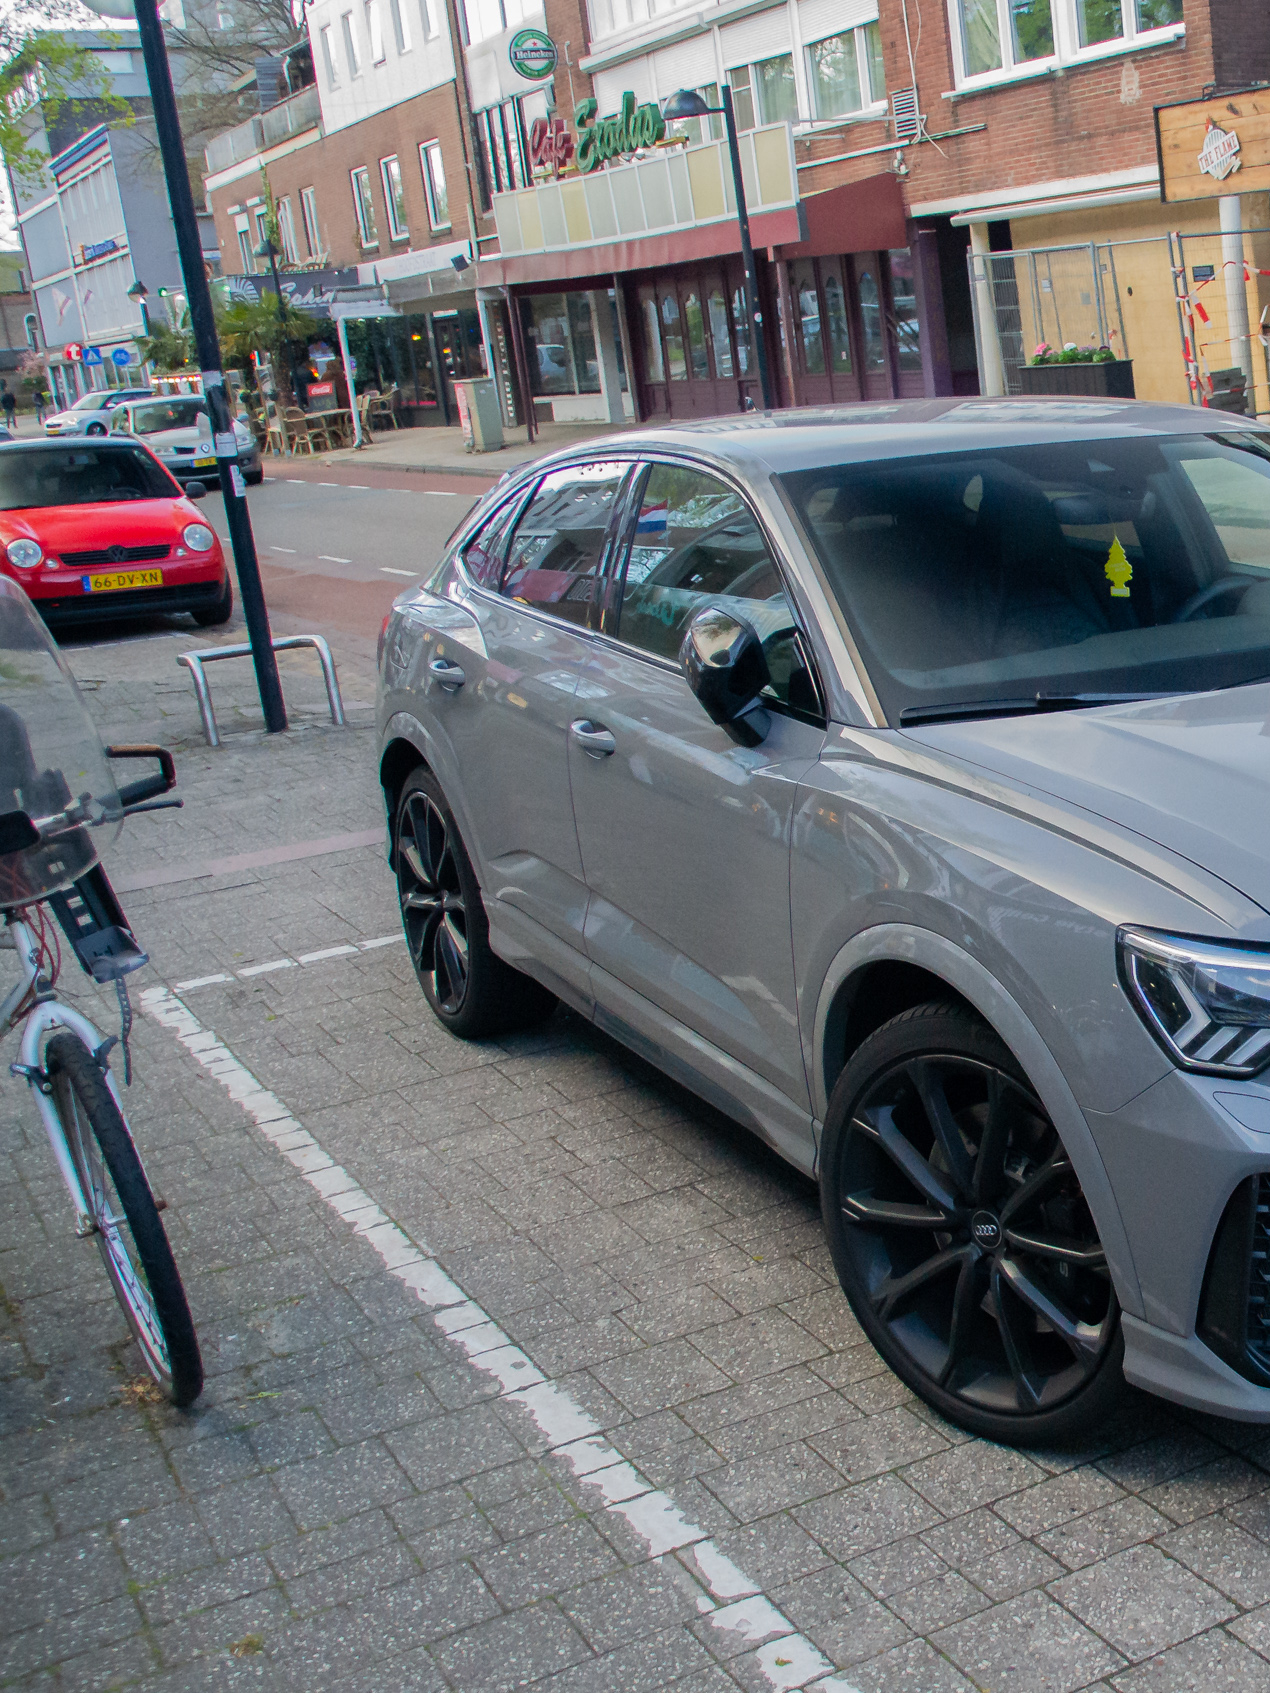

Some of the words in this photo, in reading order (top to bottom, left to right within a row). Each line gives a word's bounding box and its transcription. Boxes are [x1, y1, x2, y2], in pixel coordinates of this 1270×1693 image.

[516, 49, 554, 59] Heineken
[574, 90, 666, 174] Exodus
[1199, 151, 1215, 171] THE
[1214, 135, 1238, 161] FLAME
[94, 571, 159, 589] 66-DV-XN
